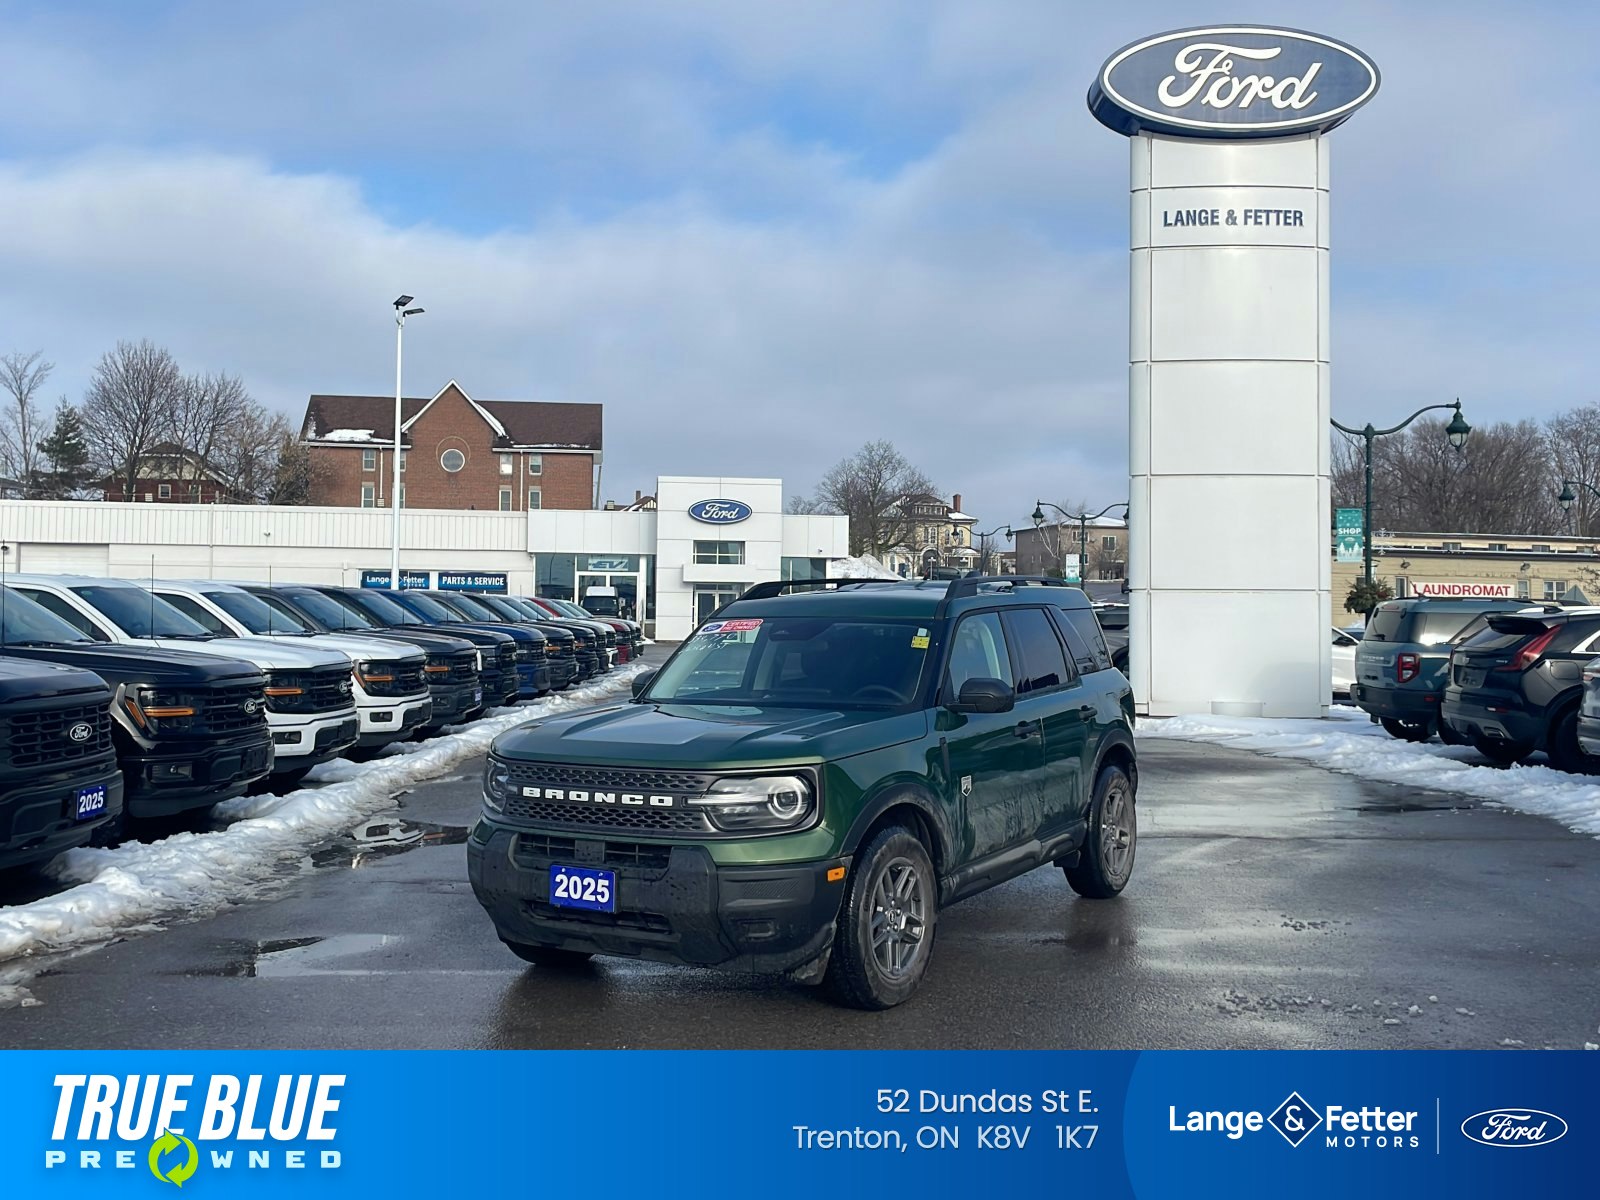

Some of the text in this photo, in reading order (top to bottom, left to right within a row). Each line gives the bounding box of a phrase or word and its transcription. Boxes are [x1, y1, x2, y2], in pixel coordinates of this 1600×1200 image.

[1157, 43, 1322, 110] Ford
[1163, 209, 1304, 227] LANGE & FETTER
[701, 502, 740, 519] Ford
[1337, 527, 1362, 535] SHOP
[366, 575, 390, 585] Lange
[442, 576, 504, 585] PARTS & SERVICE
[1413, 583, 1511, 597] LAUNDROMAT
[73, 725, 90, 740] Ford
[79, 790, 104, 814] 2025
[522, 786, 673, 807] BRONCO
[554, 874, 610, 903] 2025
